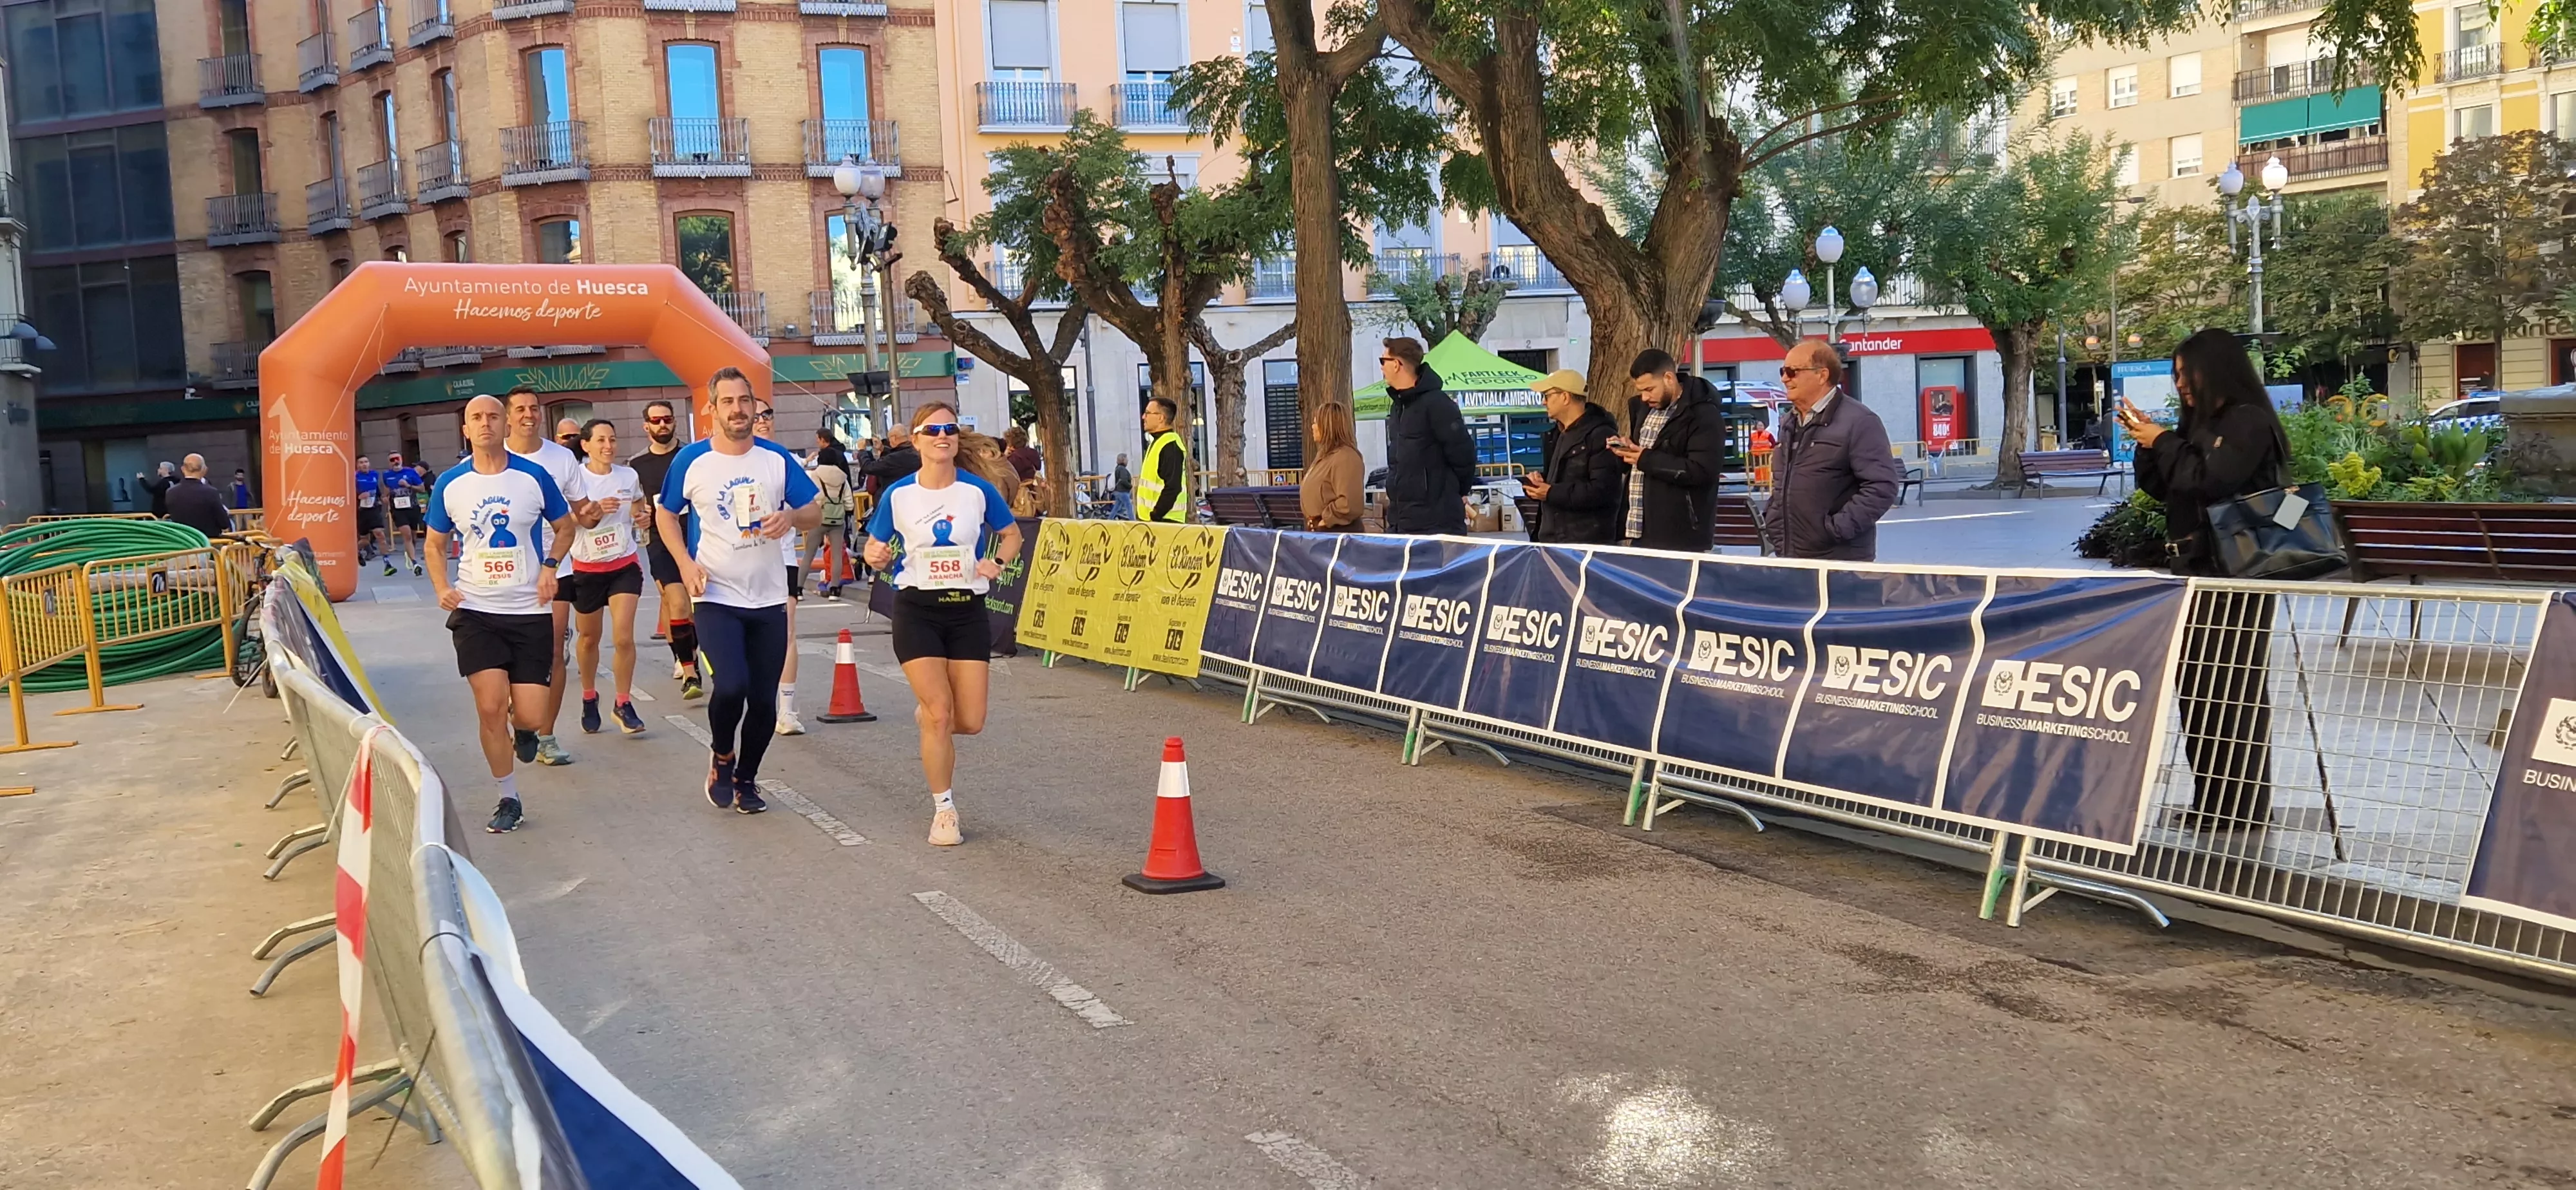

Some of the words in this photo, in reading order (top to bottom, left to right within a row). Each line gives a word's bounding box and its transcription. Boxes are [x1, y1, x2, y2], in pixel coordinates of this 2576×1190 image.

[404, 277, 542, 297] Ayuntamiento
[548, 279, 571, 295] de
[577, 279, 649, 295] Huesca
[453, 298, 532, 321] Hacemos
[536, 298, 603, 327] deporte
[1526, 340, 1531, 348] 2
[1461, 370, 1523, 379] FARTLECK
[2117, 365, 2152, 373] HUESCA
[1464, 391, 1542, 408] AVITUALLAMIENTO
[269, 429, 348, 442] Ayuntamiento
[269, 443, 280, 454] de
[285, 442, 333, 455] Huesca
[287, 489, 346, 507] Hacemos
[477, 495, 511, 509] LAGUNA
[287, 507, 339, 529] deporte
[469, 509, 480, 521] LA
[594, 533, 616, 547] 607
[484, 560, 515, 573] 566
[930, 560, 961, 573] 568
[1170, 544, 1181, 569] El
[1227, 569, 1263, 601] ESIC
[1282, 578, 1322, 612] ESIC
[1345, 587, 1390, 623] ESIC
[1417, 596, 1472, 636] ESIC
[1502, 607, 1563, 648] ESIC
[1598, 618, 1669, 663] ESIC
[1714, 632, 1795, 682] ESIC
[1852, 647, 1953, 701] ESIC
[1680, 674, 1785, 699] BUSINESS&MARKETINGSCHOOL
[2020, 661, 2141, 722] ESIC
[1815, 692, 1939, 719] BUSINESS&MARKETINGSCHOOL
[1976, 713, 2131, 744] BUSINESS&MARKETINGSCHOOL
